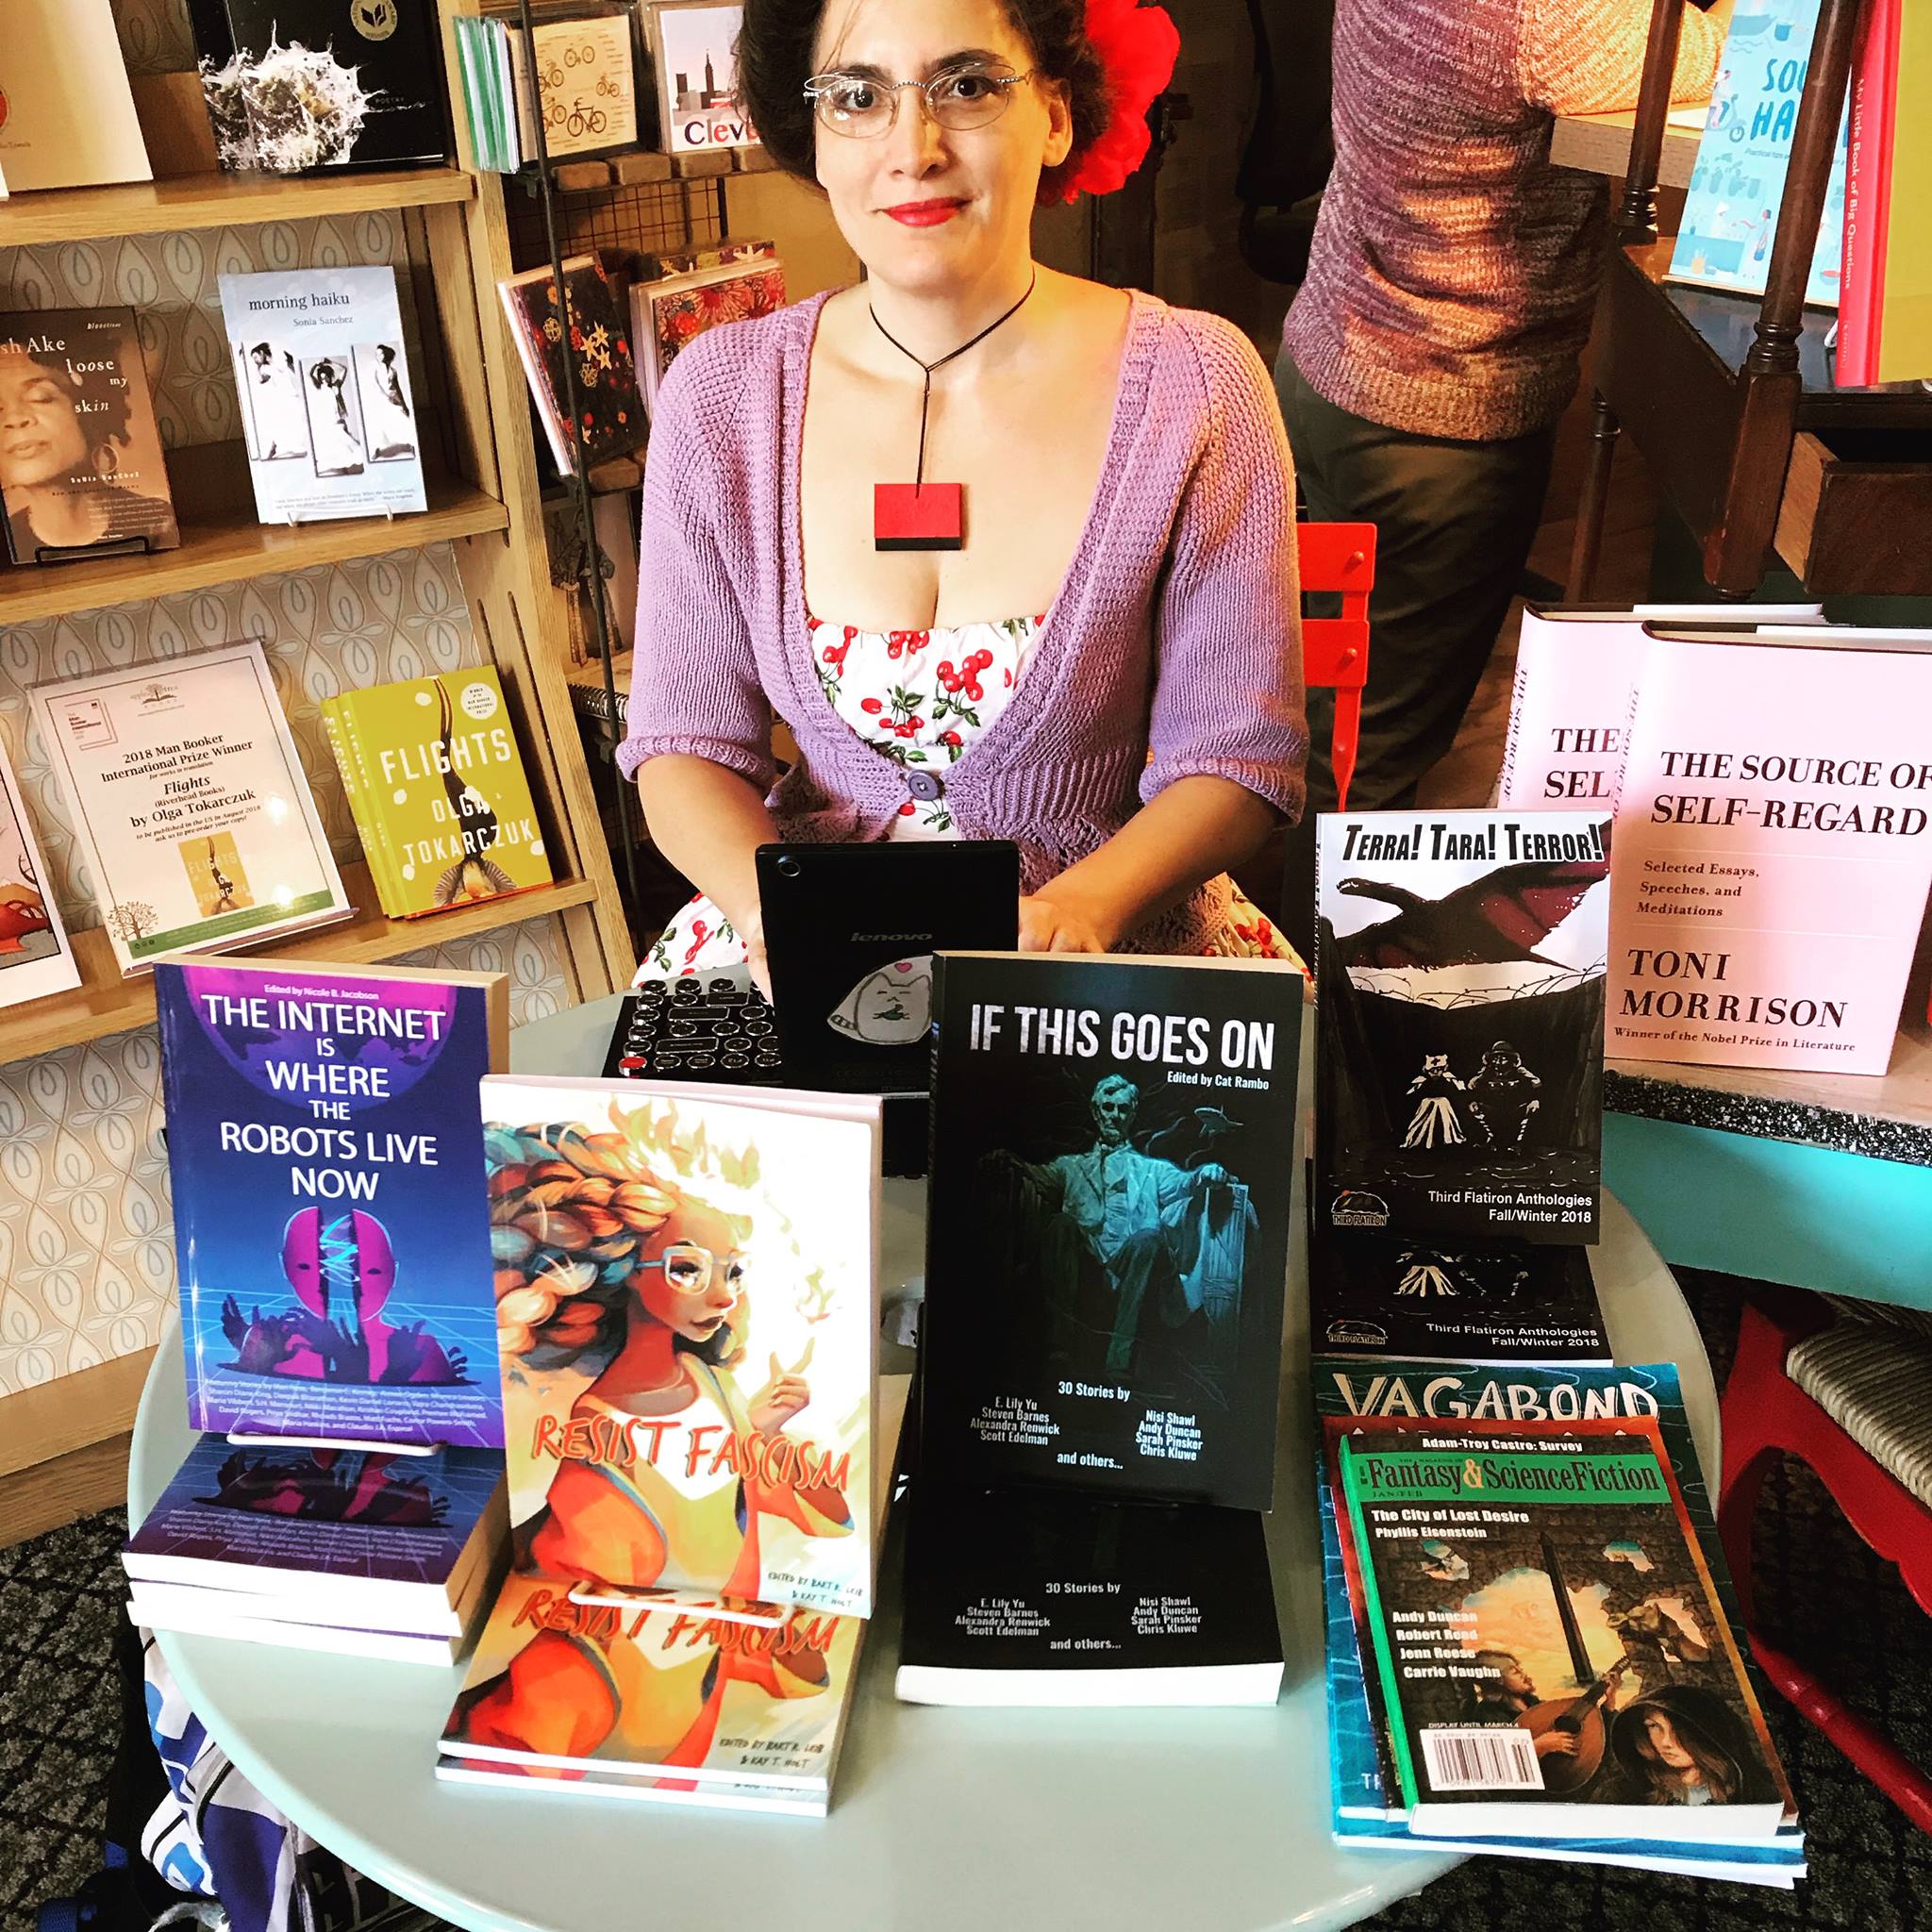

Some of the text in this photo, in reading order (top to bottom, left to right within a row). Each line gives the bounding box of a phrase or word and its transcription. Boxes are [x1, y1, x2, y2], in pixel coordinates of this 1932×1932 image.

[1856, 77, 1864, 97] My
[1852, 142, 1861, 177] Book
[1851, 180, 1858, 198] of
[1849, 199, 1857, 221] Big
[1845, 225, 1857, 289] Questions
[249, 292, 350, 310] morning haiku
[293, 316, 354, 326] Sonia Sanchez
[66, 358, 114, 374] loose
[109, 377, 127, 387] my
[75, 400, 109, 413] skin
[1517, 669, 1527, 703] THE
[123, 734, 224, 763] 2018 Man Booker
[1507, 708, 1522, 774] SOURCE
[1552, 728, 1620, 754] THE
[101, 741, 253, 782] International Prize Winner
[379, 728, 511, 785] FLIGHTS
[1660, 751, 1733, 780] THE
[1740, 755, 1882, 787] SOURCE
[164, 776, 210, 794] Flights
[1504, 777, 1511, 801] OF
[1543, 771, 1610, 798] SEL
[155, 786, 225, 808] (Riverhead Books)
[130, 789, 257, 828] by Olga Tokarczuk
[431, 791, 491, 823] OLGA
[1651, 794, 1928, 836] SELF-REGARD
[403, 818, 534, 866] TOKARCZUK
[1643, 860, 1759, 880] Selected Essays,
[1640, 881, 1741, 897] Speeches, and
[1637, 903, 1724, 917] Meditations
[851, 932, 933, 941] lenovo
[1627, 949, 1731, 981] TONI
[264, 984, 291, 994] Edited
[291, 986, 303, 996] by
[303, 987, 330, 996] Nicole
[341, 990, 379, 1000] Jacobson
[200, 994, 446, 1041] THE INTERNET
[1619, 989, 1848, 1028] MORRISON
[970, 1003, 1274, 1071] IF THIS GOES ON
[1614, 1026, 1856, 1052] Winner of the Nobel Prize in Literature
[316, 1038, 336, 1057] IS
[265, 1059, 391, 1098] WHERE
[1167, 1071, 1270, 1091] Edited by Cat Rambo
[308, 1099, 352, 1121] THE
[220, 1122, 439, 1166] ROBOTS LIVE
[291, 1167, 379, 1201] NOW
[1428, 1191, 1592, 1208] Third Flatiron Anthologies
[1333, 1215, 1353, 1225] THIRD
[1489, 1209, 1591, 1224] Fall/Winter 2018
[1426, 1323, 1597, 1339] Third Flatiron Anthologies
[1491, 1336, 1600, 1347] Fall/Winter 2018
[1058, 1381, 1131, 1402] 30 Stories by
[1333, 1374, 1658, 1421] VAGABOND
[995, 1396, 1038, 1410] E. Lily Yu
[981, 1407, 1049, 1423] Steven Barnes
[1146, 1409, 1195, 1426] Nisi Shawl
[970, 1418, 1060, 1435] Alexandra Renwick
[1139, 1420, 1201, 1439] Andy Duncan
[980, 1430, 1049, 1445] Scott Edelman
[1135, 1431, 1203, 1450] Sarah Pinsker
[1423, 1438, 1583, 1452] Adam-Troy Castro: Survey
[532, 1415, 851, 1492] RESIST FASCISM
[1057, 1452, 1124, 1469] and others...
[1140, 1443, 1196, 1460] Chris Kluwe
[1367, 1458, 1461, 1495] Fantasy
[1463, 1458, 1484, 1489] &
[1372, 1509, 1529, 1524] The City of Lost Desire
[1375, 1526, 1487, 1539] Phyllis Eisenstein
[768, 1572, 794, 1582] EDITED
[811, 1578, 832, 1589] BART
[801, 1592, 816, 1601] KAY
[1392, 1611, 1478, 1623] Andy Duncan
[1396, 1629, 1478, 1641] Robert Reed
[1400, 1647, 1476, 1659] Jenn Reese
[1404, 1666, 1501, 1678] Carrie Vaughn
